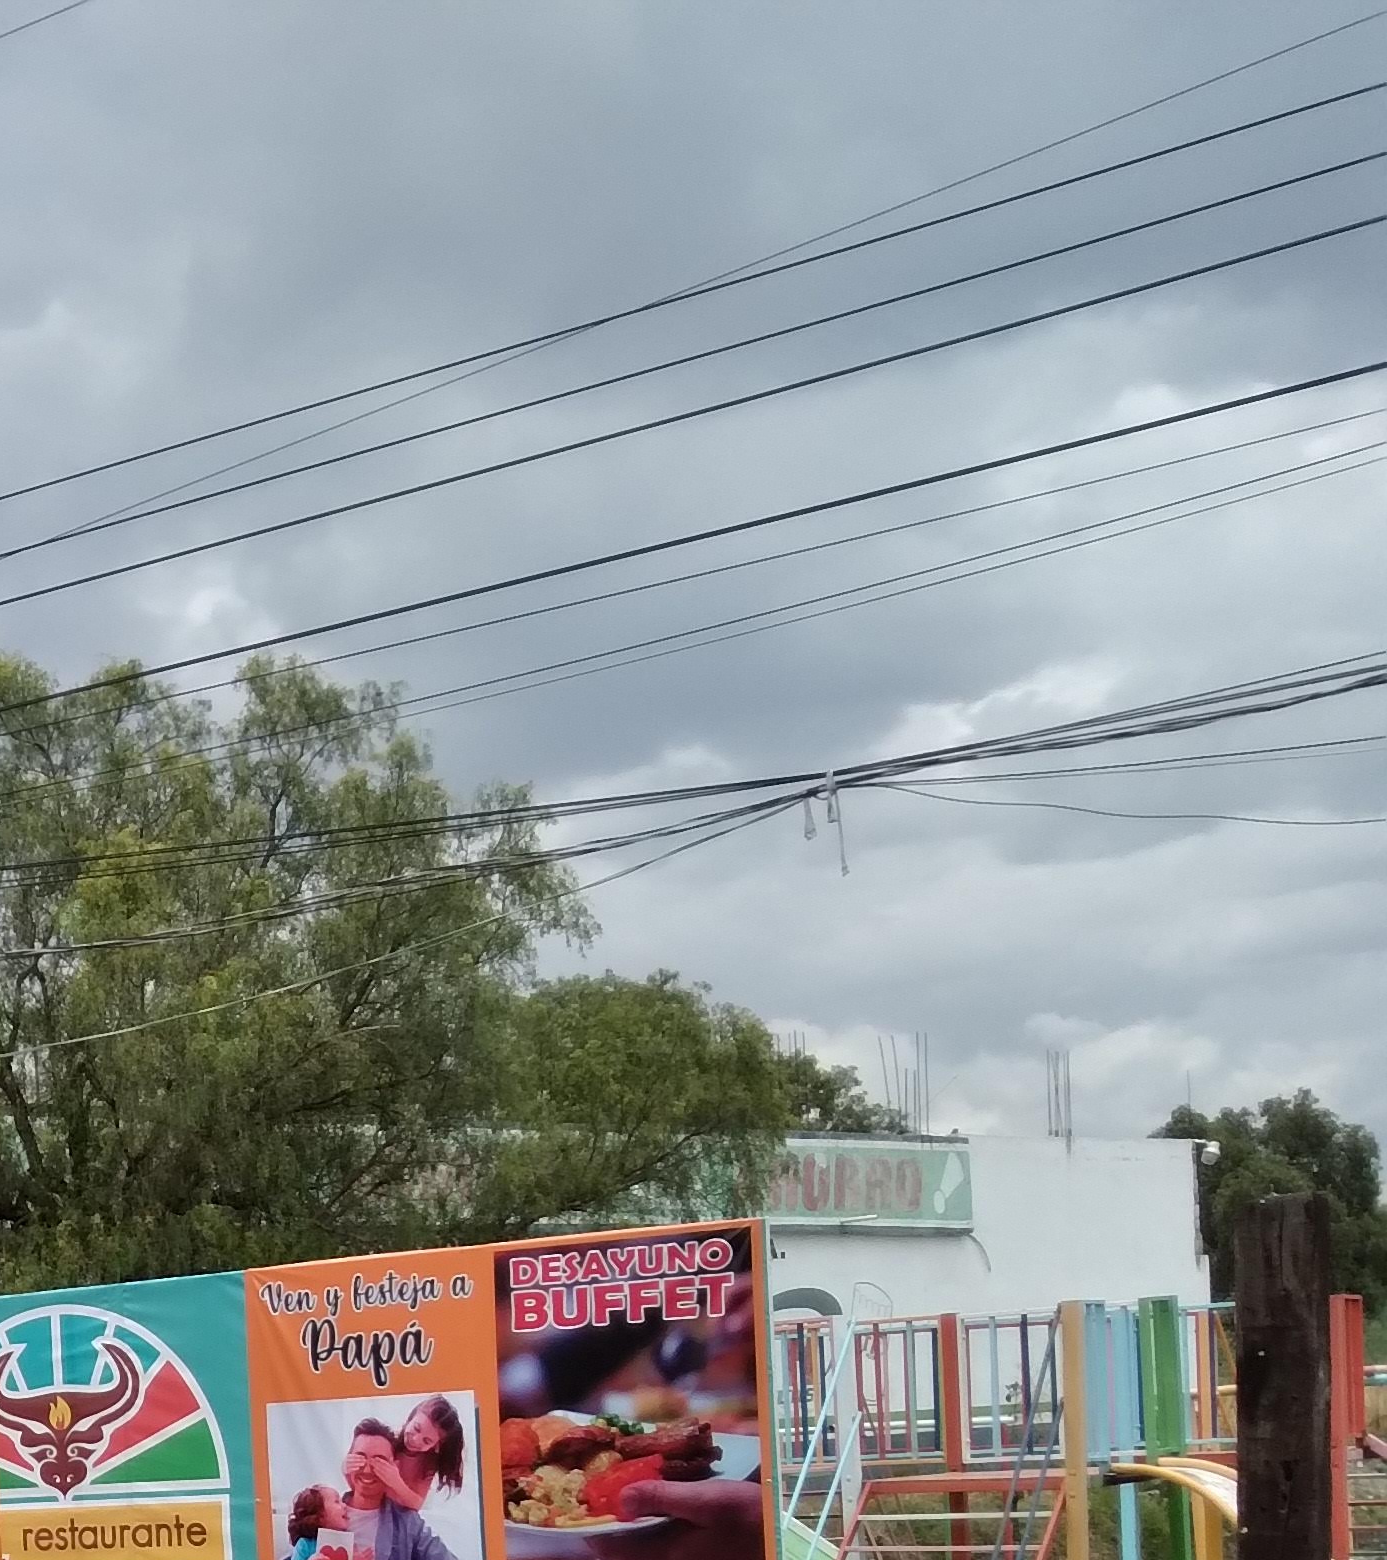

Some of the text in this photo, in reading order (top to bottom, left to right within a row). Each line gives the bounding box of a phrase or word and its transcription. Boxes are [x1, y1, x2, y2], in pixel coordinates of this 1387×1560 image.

[510, 1238, 733, 1288] DESAYUNO
[260, 1270, 474, 1316] Ven y festeja a
[511, 1272, 734, 1333] BUFFET
[301, 1317, 434, 1388] Papá
[22, 1515, 207, 1551] restaurante
